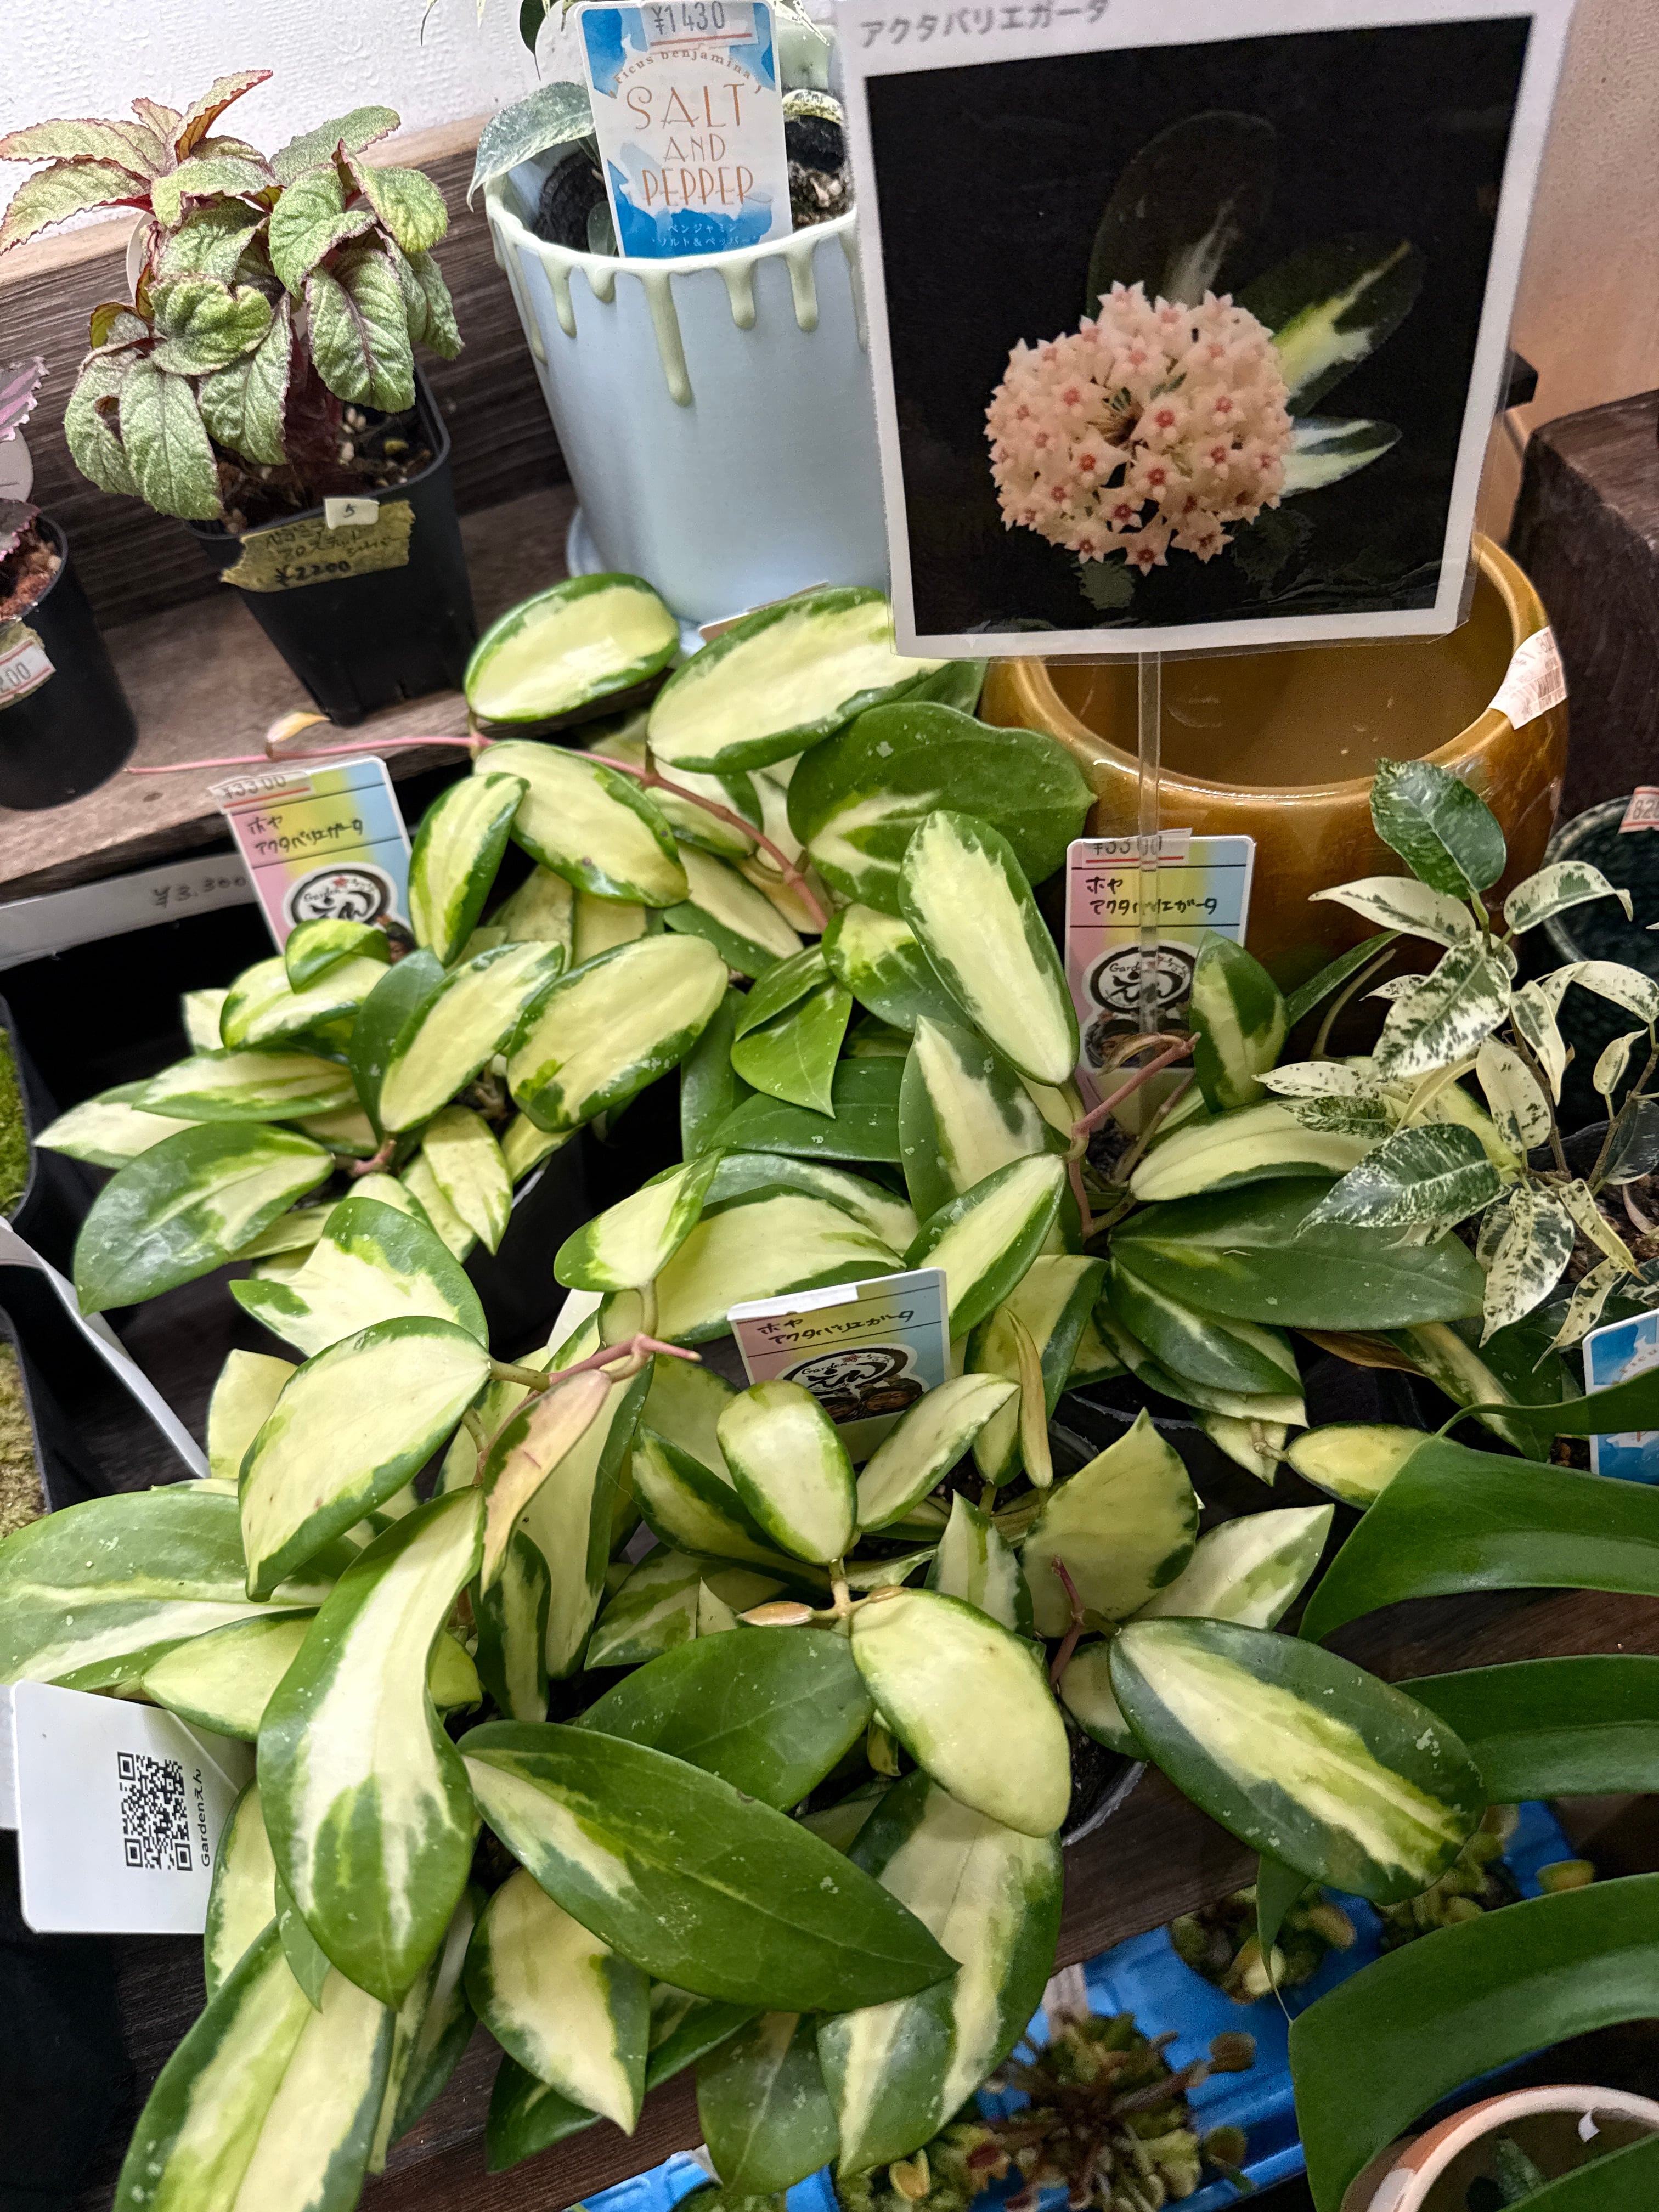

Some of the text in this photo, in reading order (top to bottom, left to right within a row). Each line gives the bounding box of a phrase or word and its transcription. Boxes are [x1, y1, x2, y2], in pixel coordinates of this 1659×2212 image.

[651, 2, 725, 35] ¥1430
[660, 49, 751, 79] benjamina
[627, 83, 744, 131] SALT
[664, 133, 726, 163] AND
[641, 166, 772, 207] PEPPER
[342, 503, 358, 518] 5
[247, 816, 283, 834] ホヤ
[1085, 876, 1124, 894] ホヤ
[757, 1318, 804, 1335] ホヤ
[802, 1362, 848, 1375] Garden
